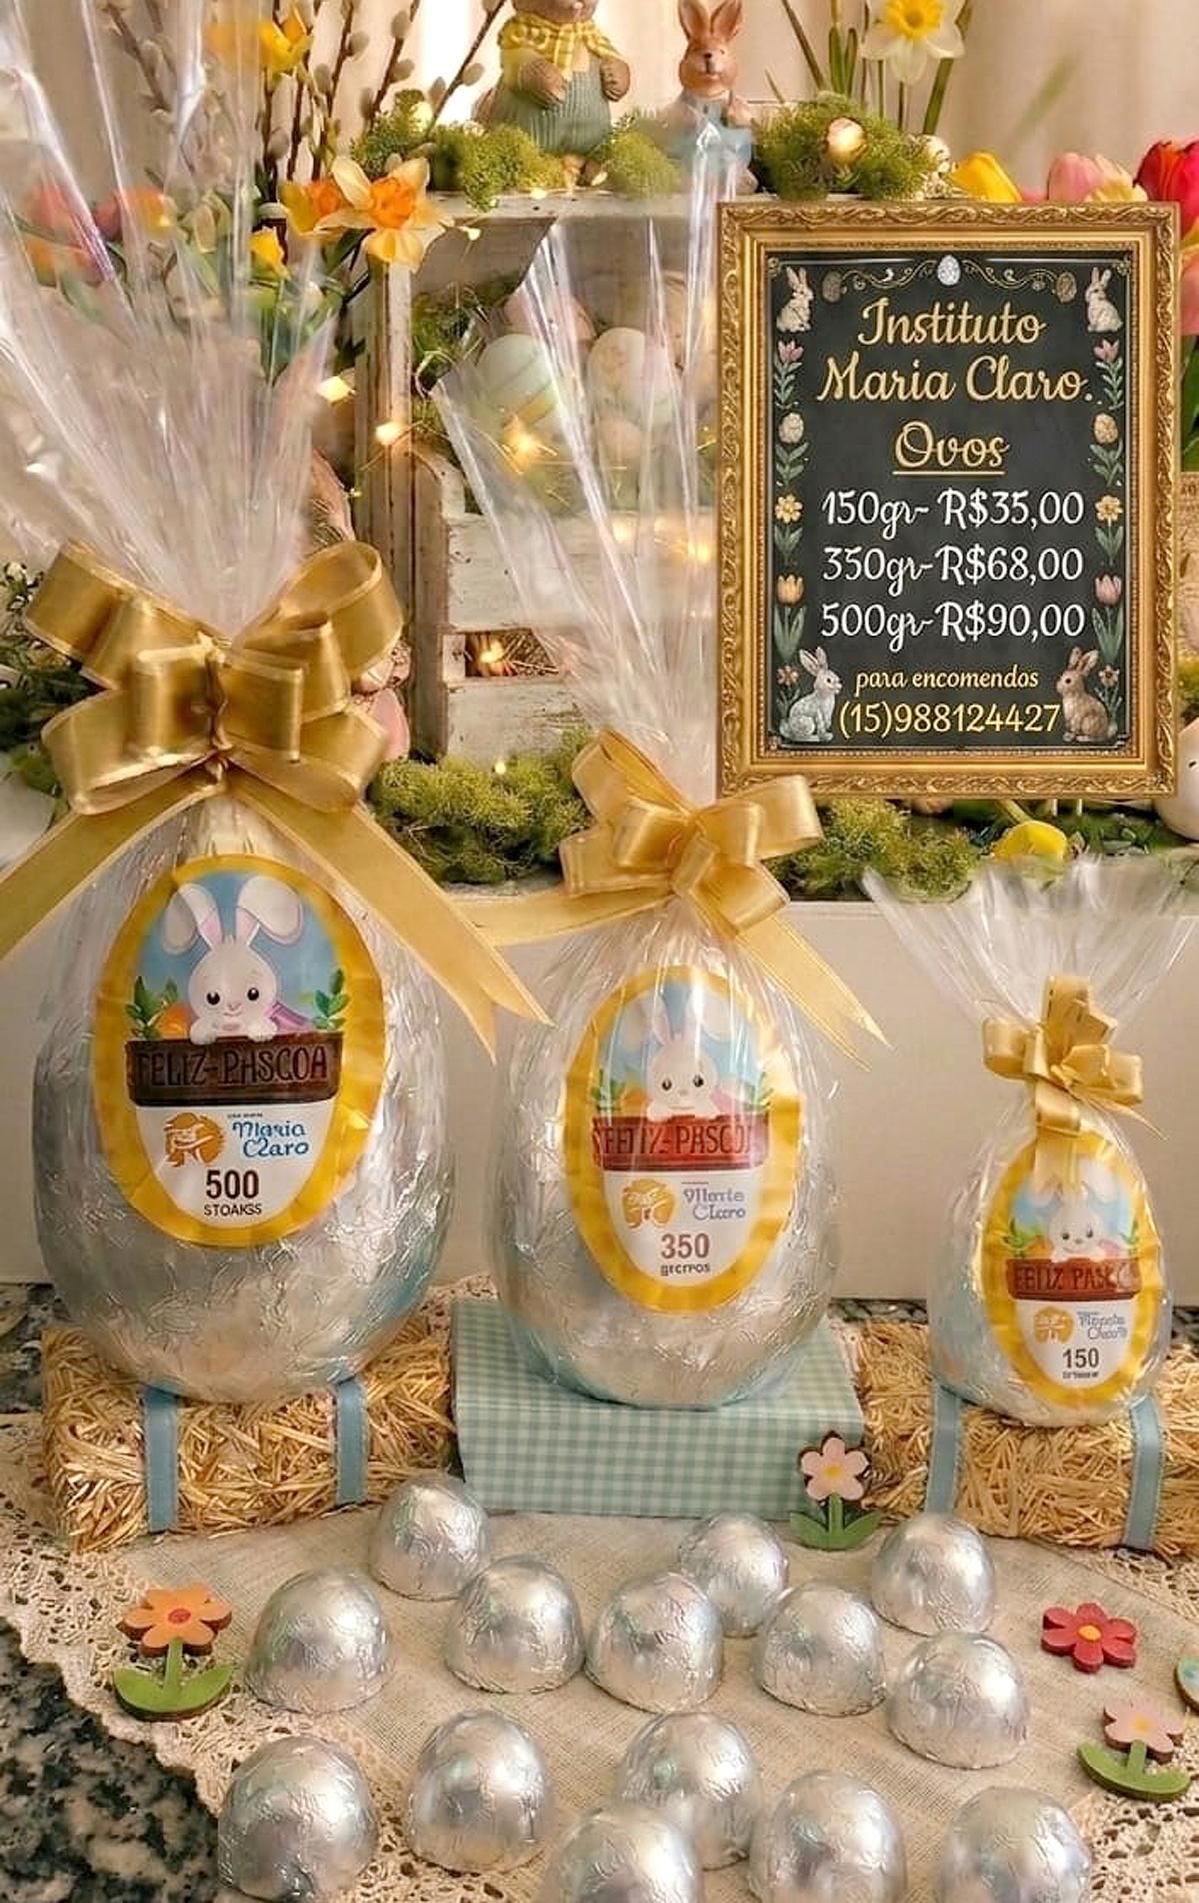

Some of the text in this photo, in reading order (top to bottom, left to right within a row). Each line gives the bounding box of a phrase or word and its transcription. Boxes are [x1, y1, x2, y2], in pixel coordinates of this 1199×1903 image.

[858, 296, 1047, 345] Instituto
[817, 350, 956, 401] Maria
[895, 420, 1010, 468] Ovos
[936, 487, 1084, 530] R$35,00
[854, 671, 908, 697] para
[840, 701, 1061, 739] (15)988124427
[206, 1170, 259, 1199] 500
[661, 1233, 710, 1259] 350
[1063, 1347, 1099, 1369] 150
